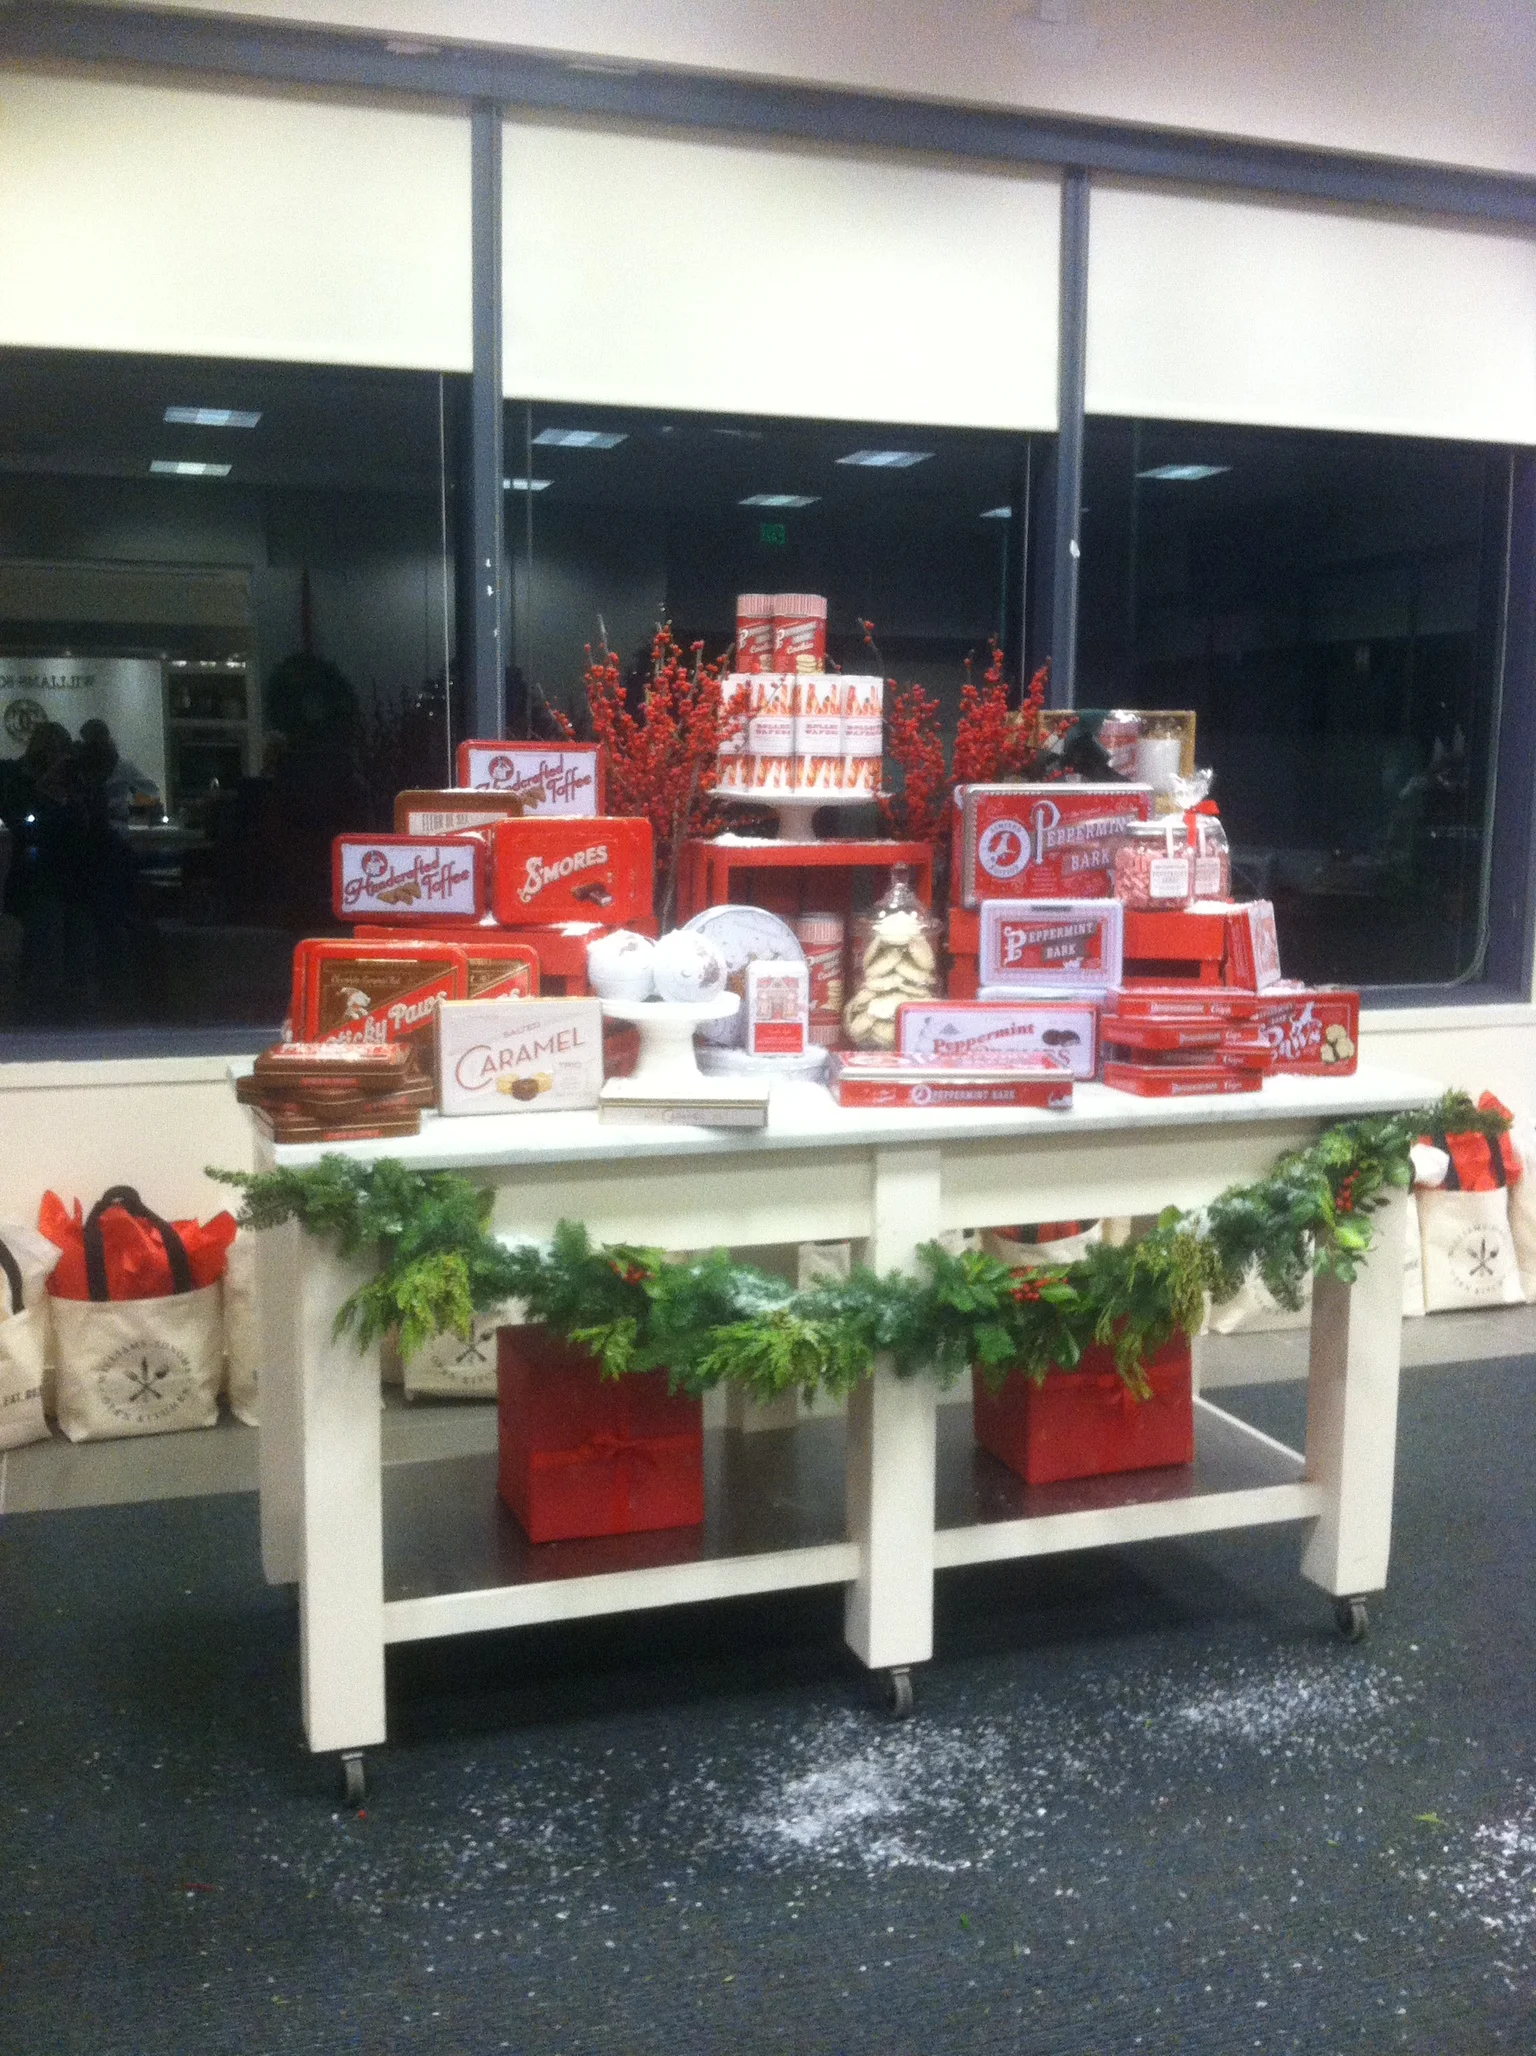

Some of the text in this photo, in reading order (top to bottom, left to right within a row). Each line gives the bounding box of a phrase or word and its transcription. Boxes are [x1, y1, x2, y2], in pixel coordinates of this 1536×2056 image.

[546, 766, 592, 803] Toffee
[1070, 848, 1110, 872] BARK
[422, 861, 470, 900] Toffee
[1004, 921, 1094, 968] PEPPERMINT
[455, 1027, 586, 1091] CARAMEL
